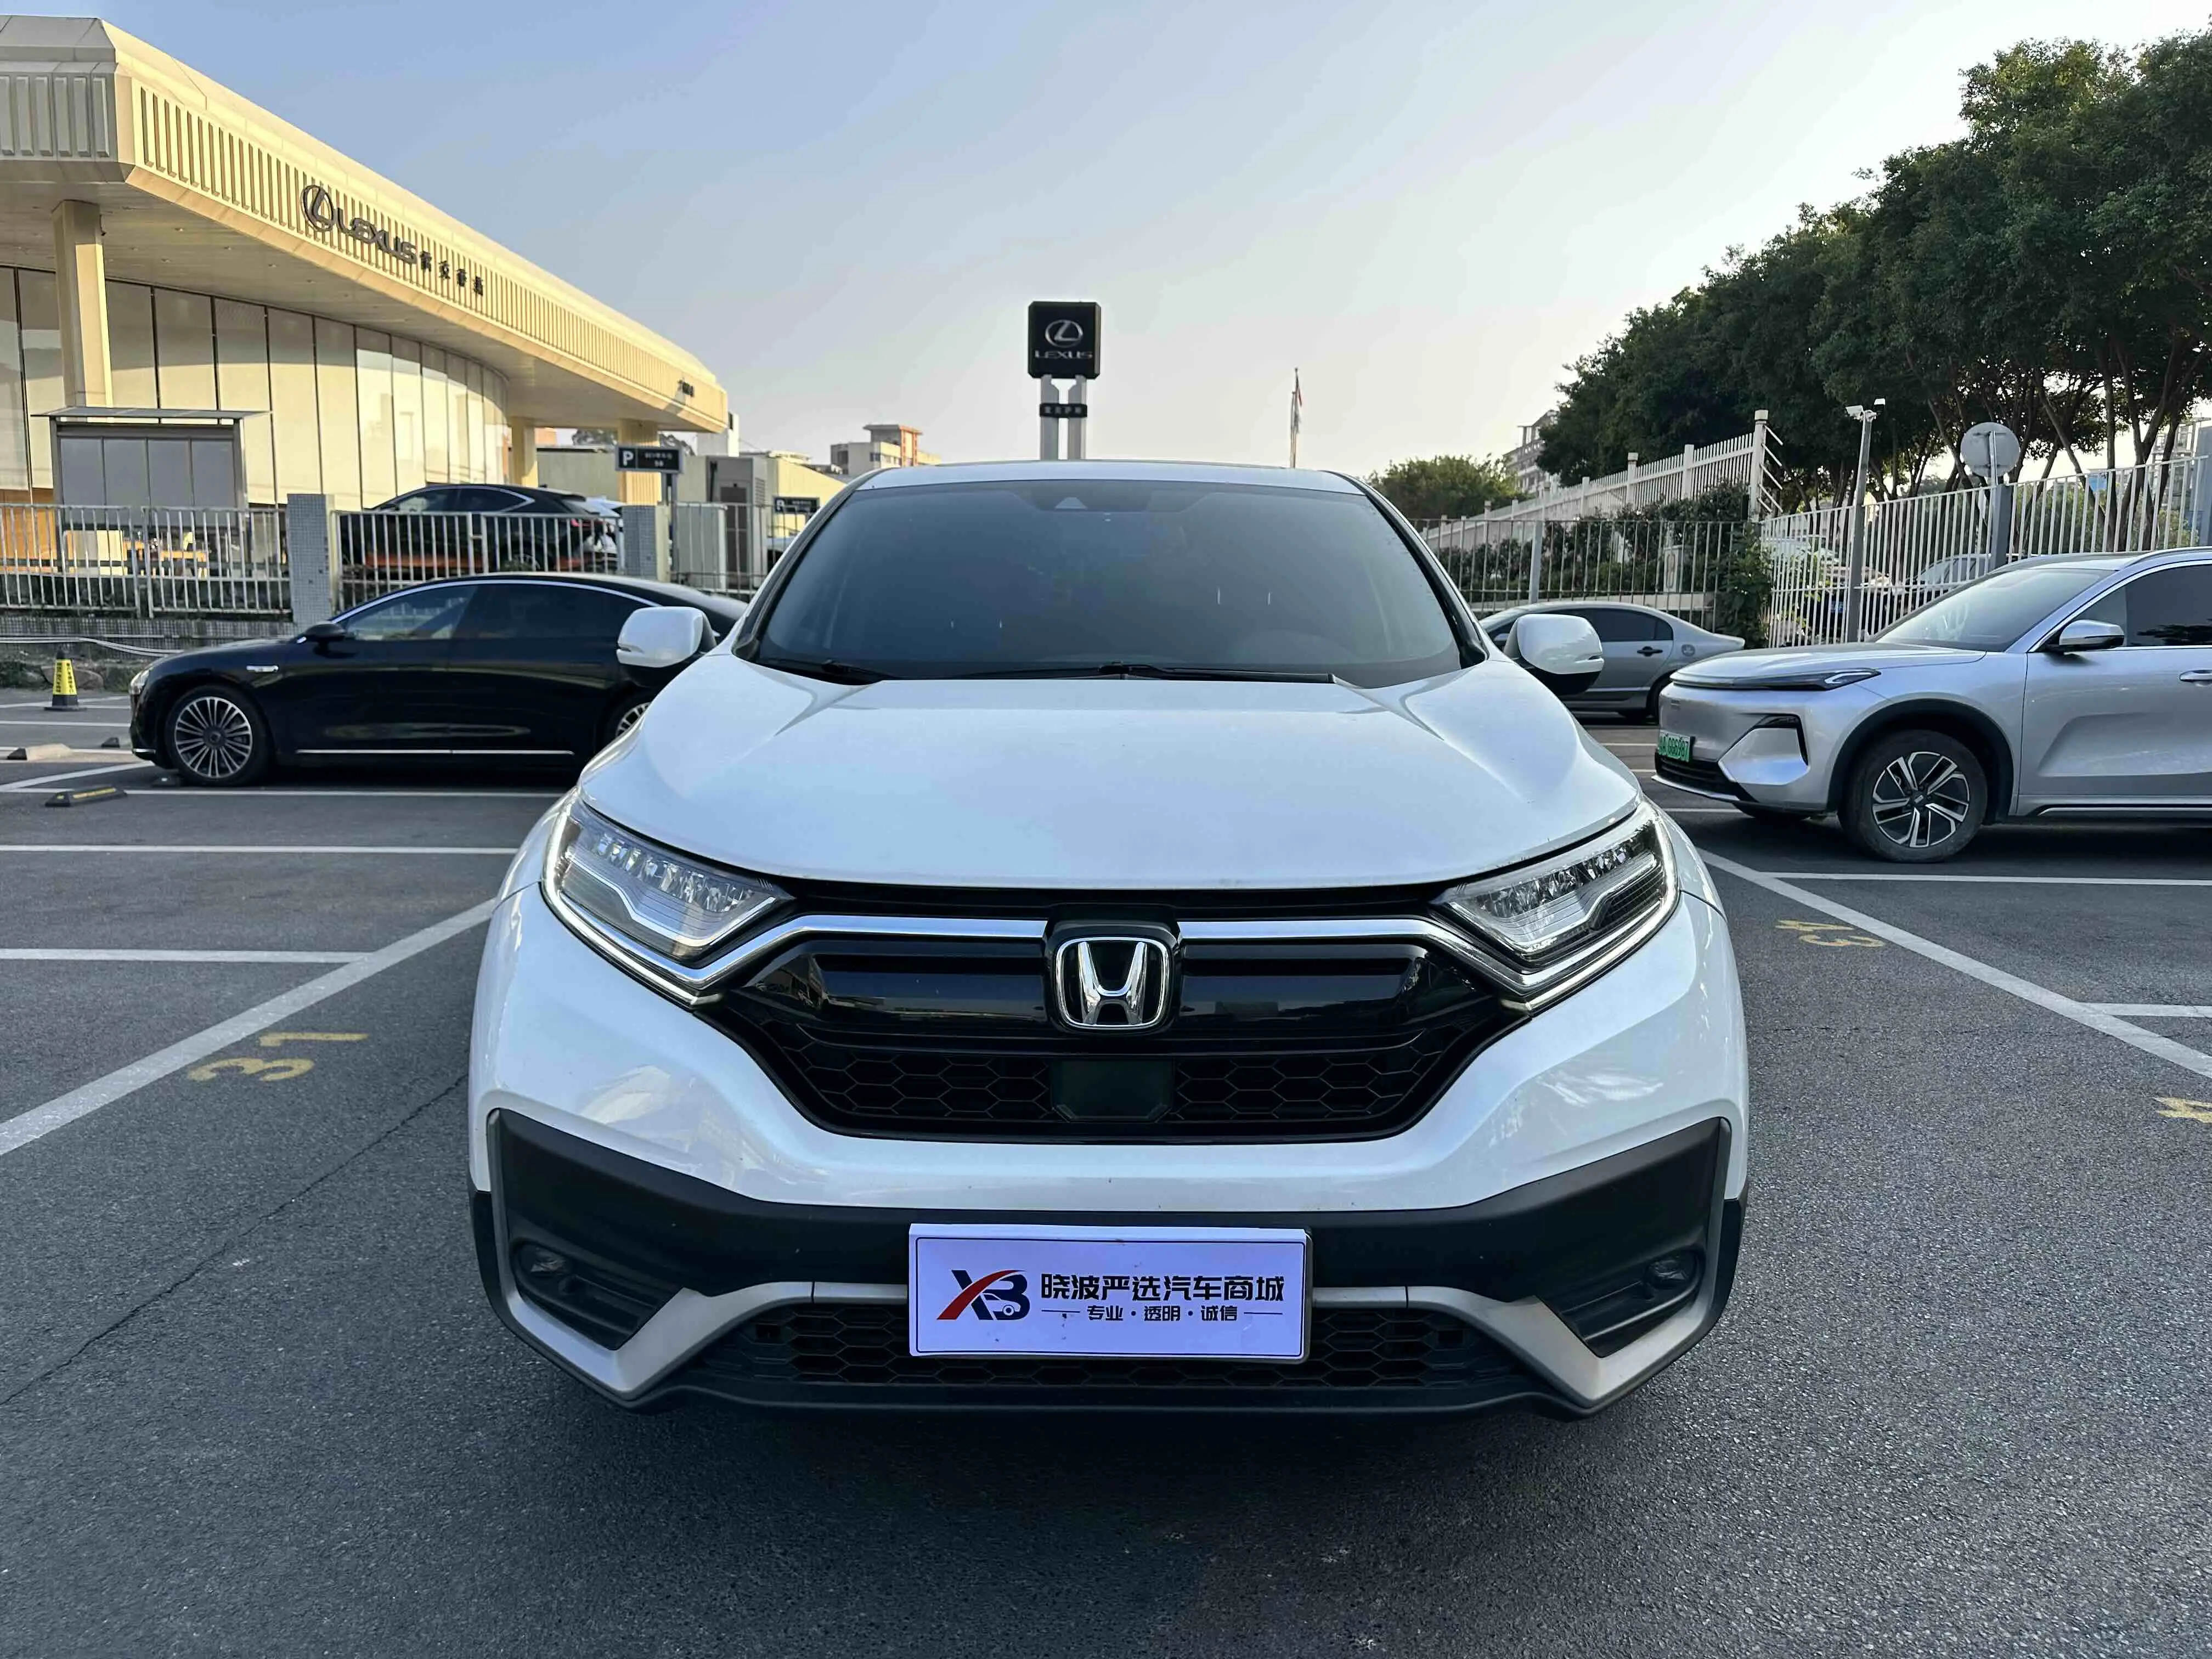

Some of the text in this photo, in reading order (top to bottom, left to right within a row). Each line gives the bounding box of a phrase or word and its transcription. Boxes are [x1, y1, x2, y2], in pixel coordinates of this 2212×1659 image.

[336, 207, 417, 264] LEXUS
[1035, 350, 1093, 359] LEXUS
[623, 450, 634, 466] P
[1041, 1273, 1284, 1301] 晓波严选汽车商城
